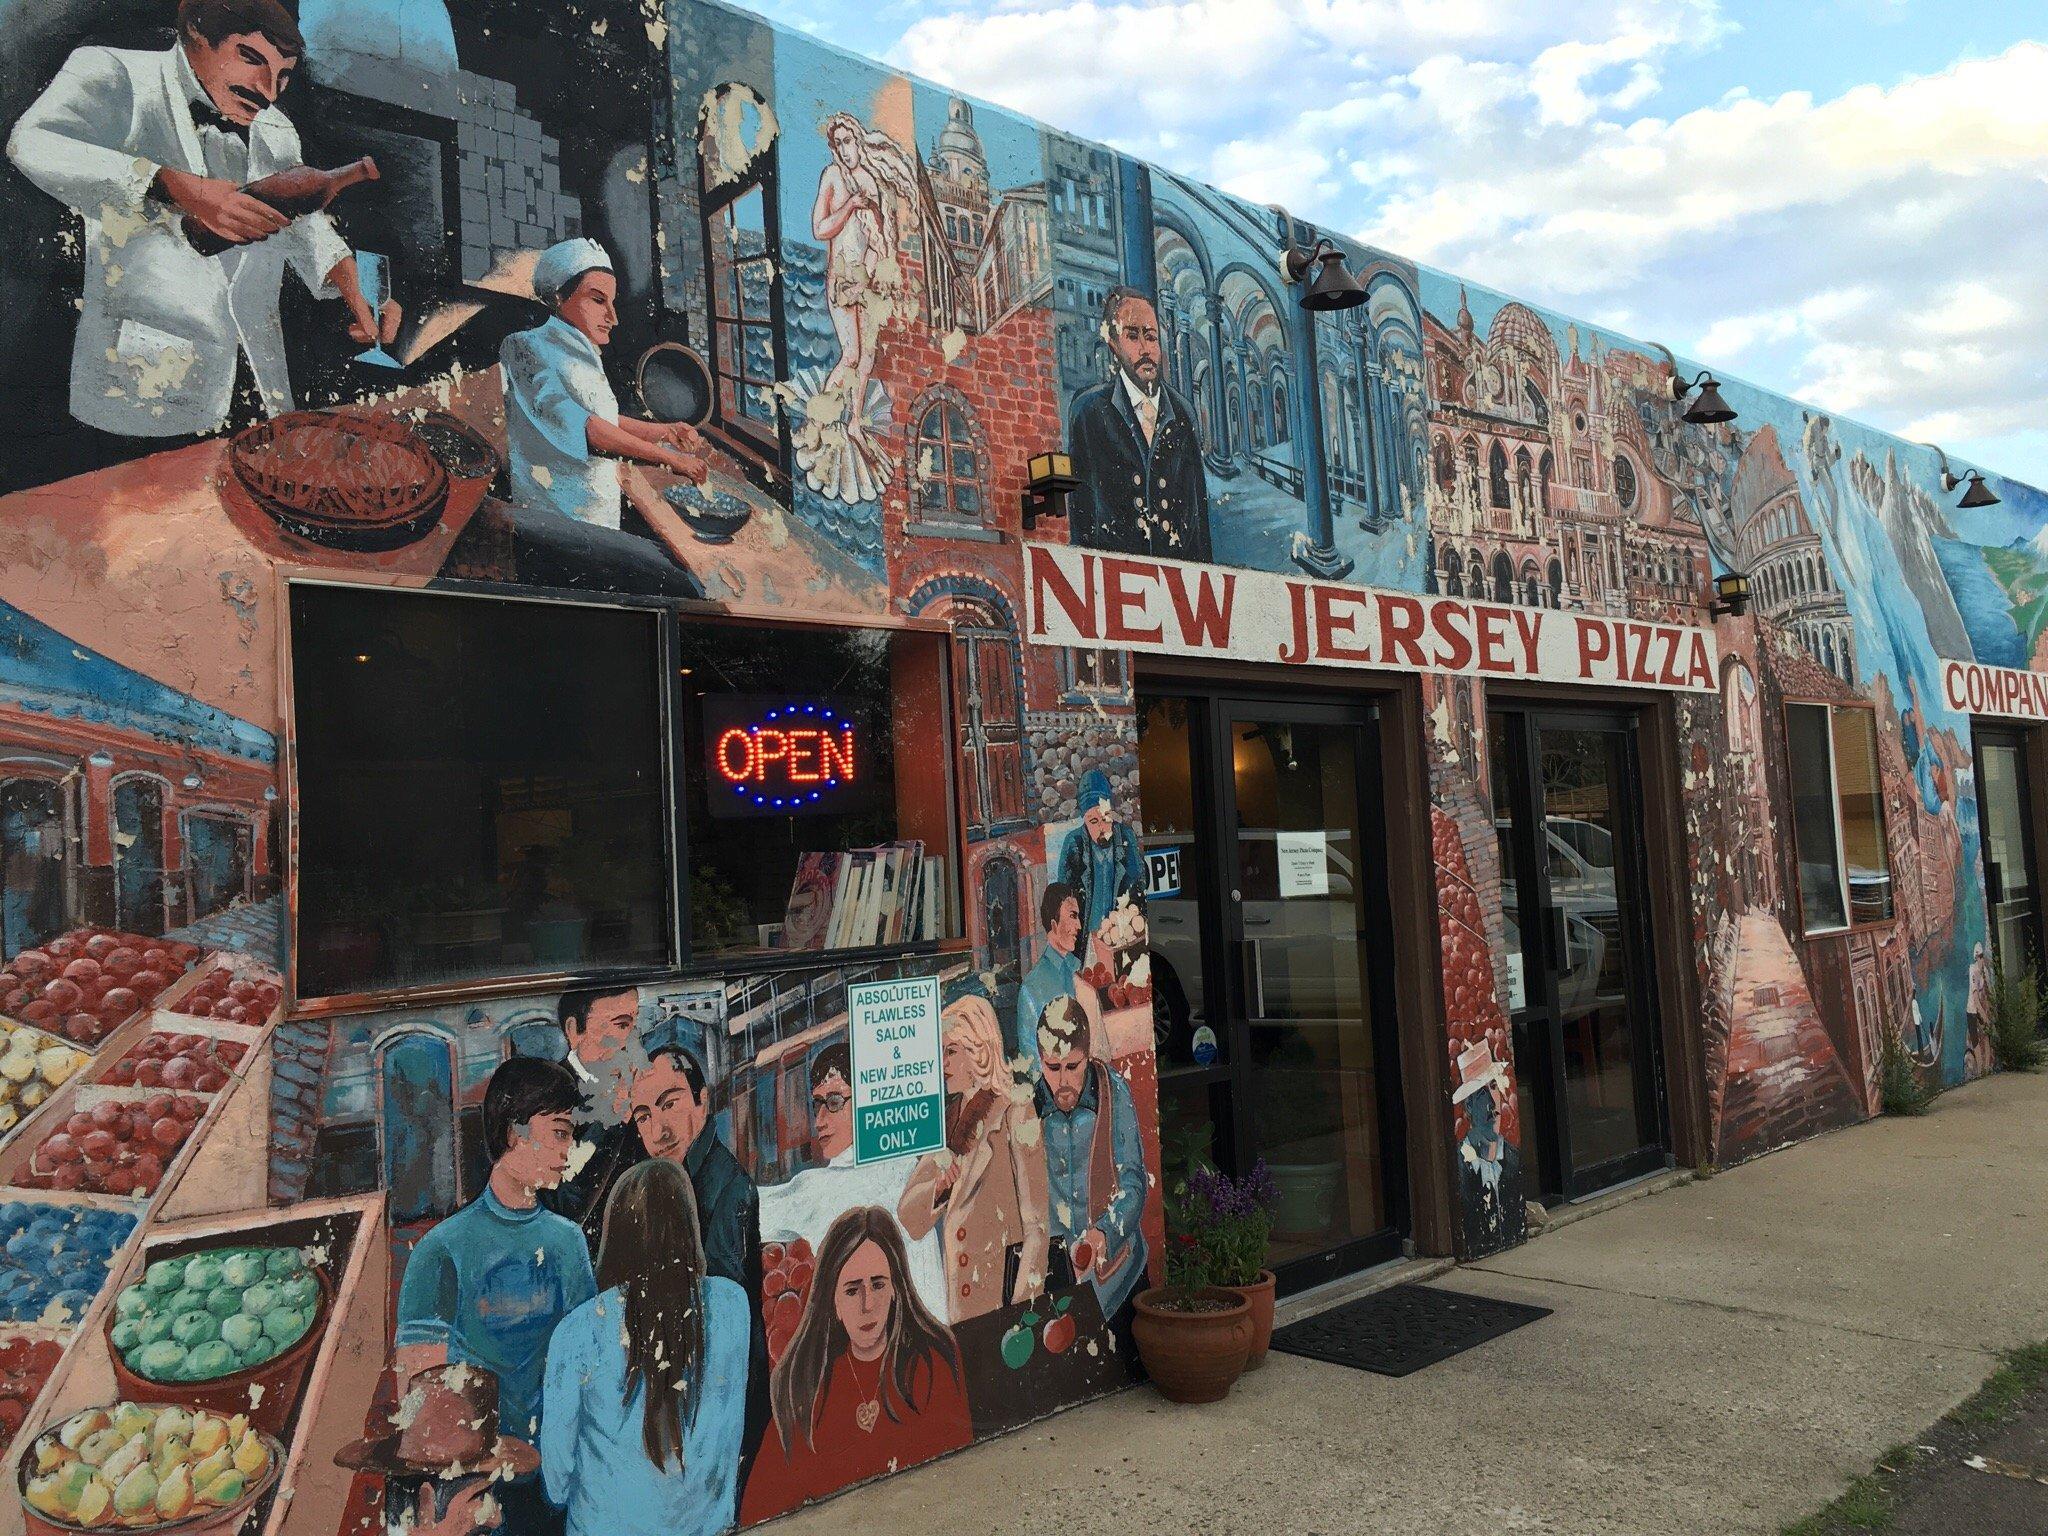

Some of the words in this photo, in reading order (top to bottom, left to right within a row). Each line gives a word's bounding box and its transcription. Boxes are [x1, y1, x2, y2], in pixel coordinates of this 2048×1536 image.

[1027, 546, 1236, 649] NEW
[1278, 581, 1544, 675] JERSEY
[1574, 617, 1716, 689] PIZZA
[717, 728, 854, 781] OPEN
[1142, 851, 1179, 892] PE
[856, 984, 932, 1006] ABSOLUTELY
[864, 1004, 926, 1025] FLAWLESS
[876, 1024, 916, 1043] SALON
[893, 1045, 901, 1060] &
[860, 1067, 887, 1084] NEW
[890, 1060, 934, 1079] JERSEY
[870, 1084, 904, 1102] PIZZA
[907, 1081, 927, 1096] CO.
[865, 1101, 930, 1130] PARKING
[879, 1127, 918, 1151] ONLY
